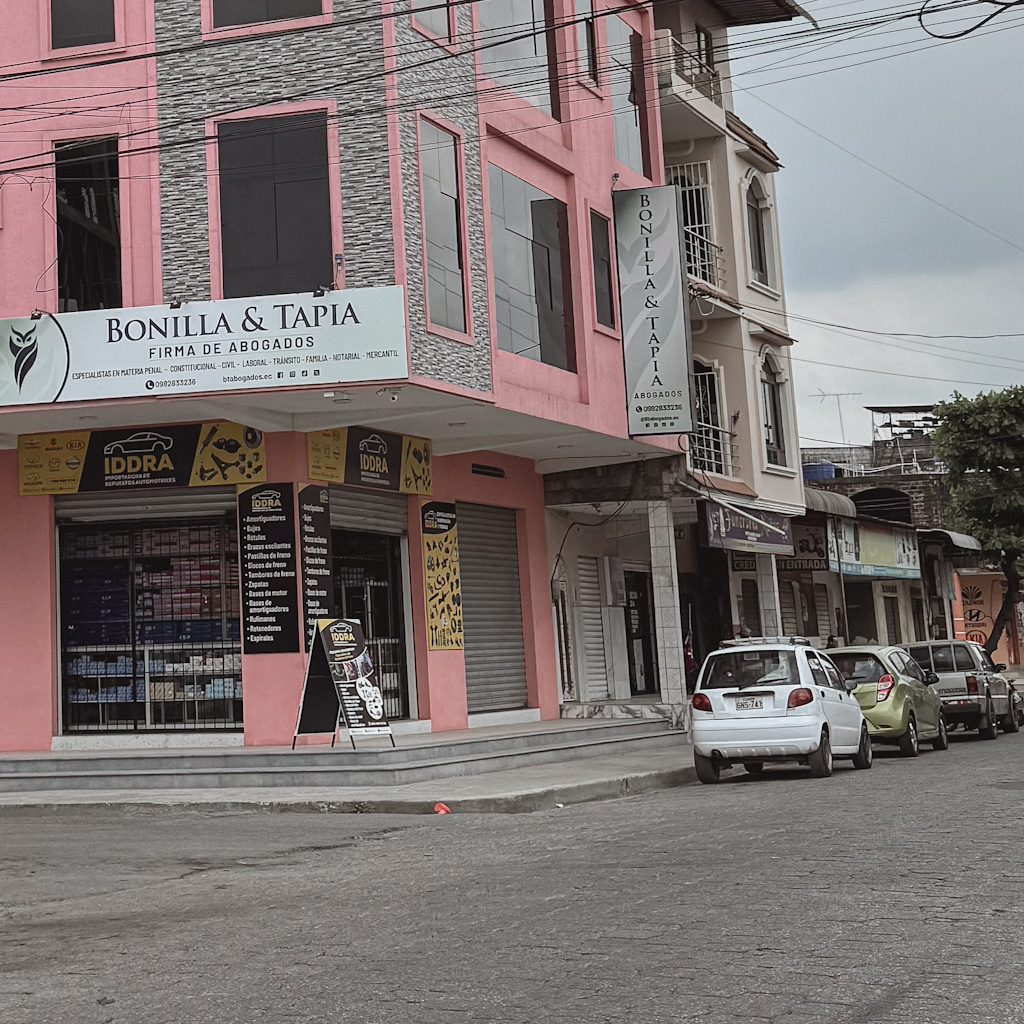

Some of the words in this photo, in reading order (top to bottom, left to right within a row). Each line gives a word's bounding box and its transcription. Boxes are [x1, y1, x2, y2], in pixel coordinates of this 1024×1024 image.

[638, 194, 657, 290] BONILLA
[644, 295, 660, 309] &
[107, 312, 234, 344] BONILLA
[241, 306, 269, 333] &
[273, 302, 362, 330] TAPIA
[149, 345, 196, 359] FIRMA
[203, 342, 221, 355] DE
[229, 336, 315, 353] ABOGADOS
[646, 316, 663, 387] TAPIA
[72, 370, 111, 380] ESPECIALISTAS
[112, 369, 120, 377] EN
[121, 368, 143, 376] MATERIA
[144, 366, 162, 375] PENAL
[170, 362, 217, 373] CONSTITUCIONAL
[221, 360, 236, 369] CIVIL
[242, 358, 267, 368] LABORAL
[305, 354, 328, 364] FAMILIA
[332, 352, 361, 362] NOTARIAL
[366, 350, 400, 359] MERCANTIL
[222, 372, 273, 383] btabogados.ec
[634, 390, 683, 400] ABOGADOS
[104, 453, 175, 474] IDDRA
[360, 453, 389, 474] IDDRA
[105, 473, 142, 481] IMPORTADORA
[135, 477, 176, 485] AUTOMOTRICES
[252, 499, 282, 507] IDDRA
[246, 515, 286, 523] Amortiguadores
[247, 525, 261, 533] Bujes
[247, 552, 269, 560] Pastillas
[786, 559, 827, 570] ENTRADA
[248, 581, 269, 589] Zapatas
[249, 606, 289, 614] amortiguadores
[331, 632, 356, 641] IDDRA
[938, 687, 966, 695] mazda
